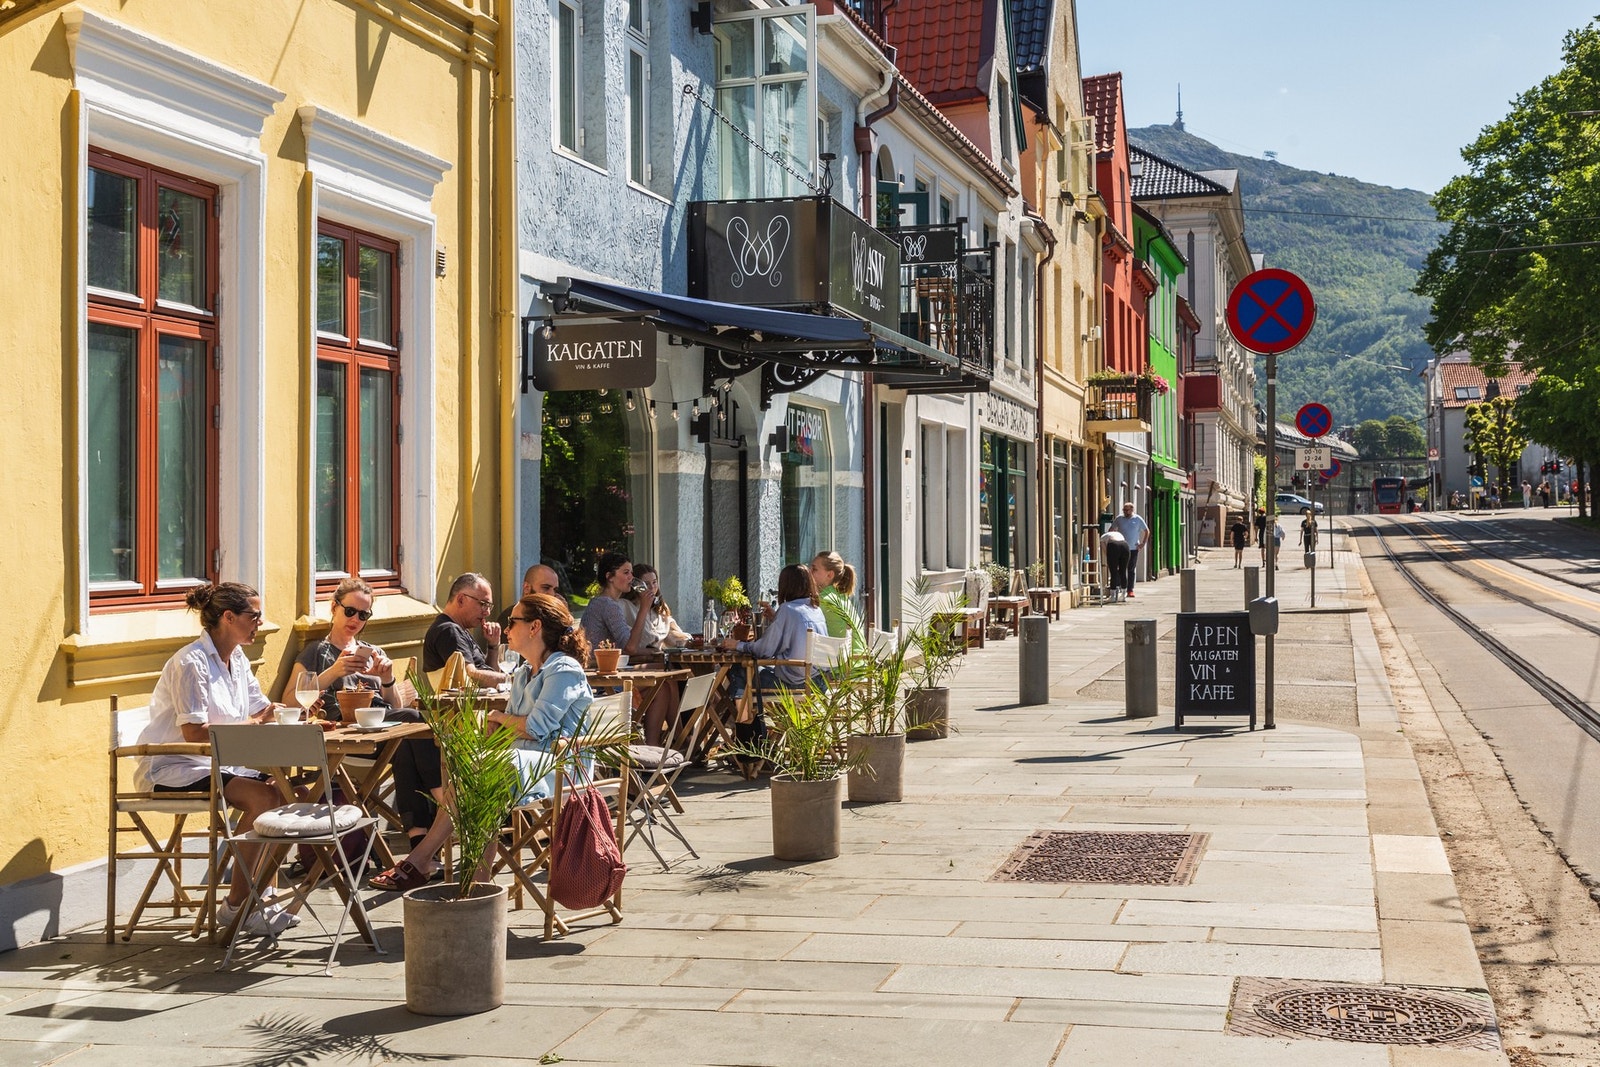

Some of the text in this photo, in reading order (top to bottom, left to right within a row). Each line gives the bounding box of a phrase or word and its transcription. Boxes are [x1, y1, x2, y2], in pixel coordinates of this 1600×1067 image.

[547, 340, 642, 361] KAIGATEN
[796, 410, 823, 441] FRISØR
[1189, 623, 1239, 646] ÅPEN
[1190, 650, 1239, 661] KAIGATEN
[1190, 664, 1216, 680] VIN
[1190, 684, 1235, 701] KAFFE
